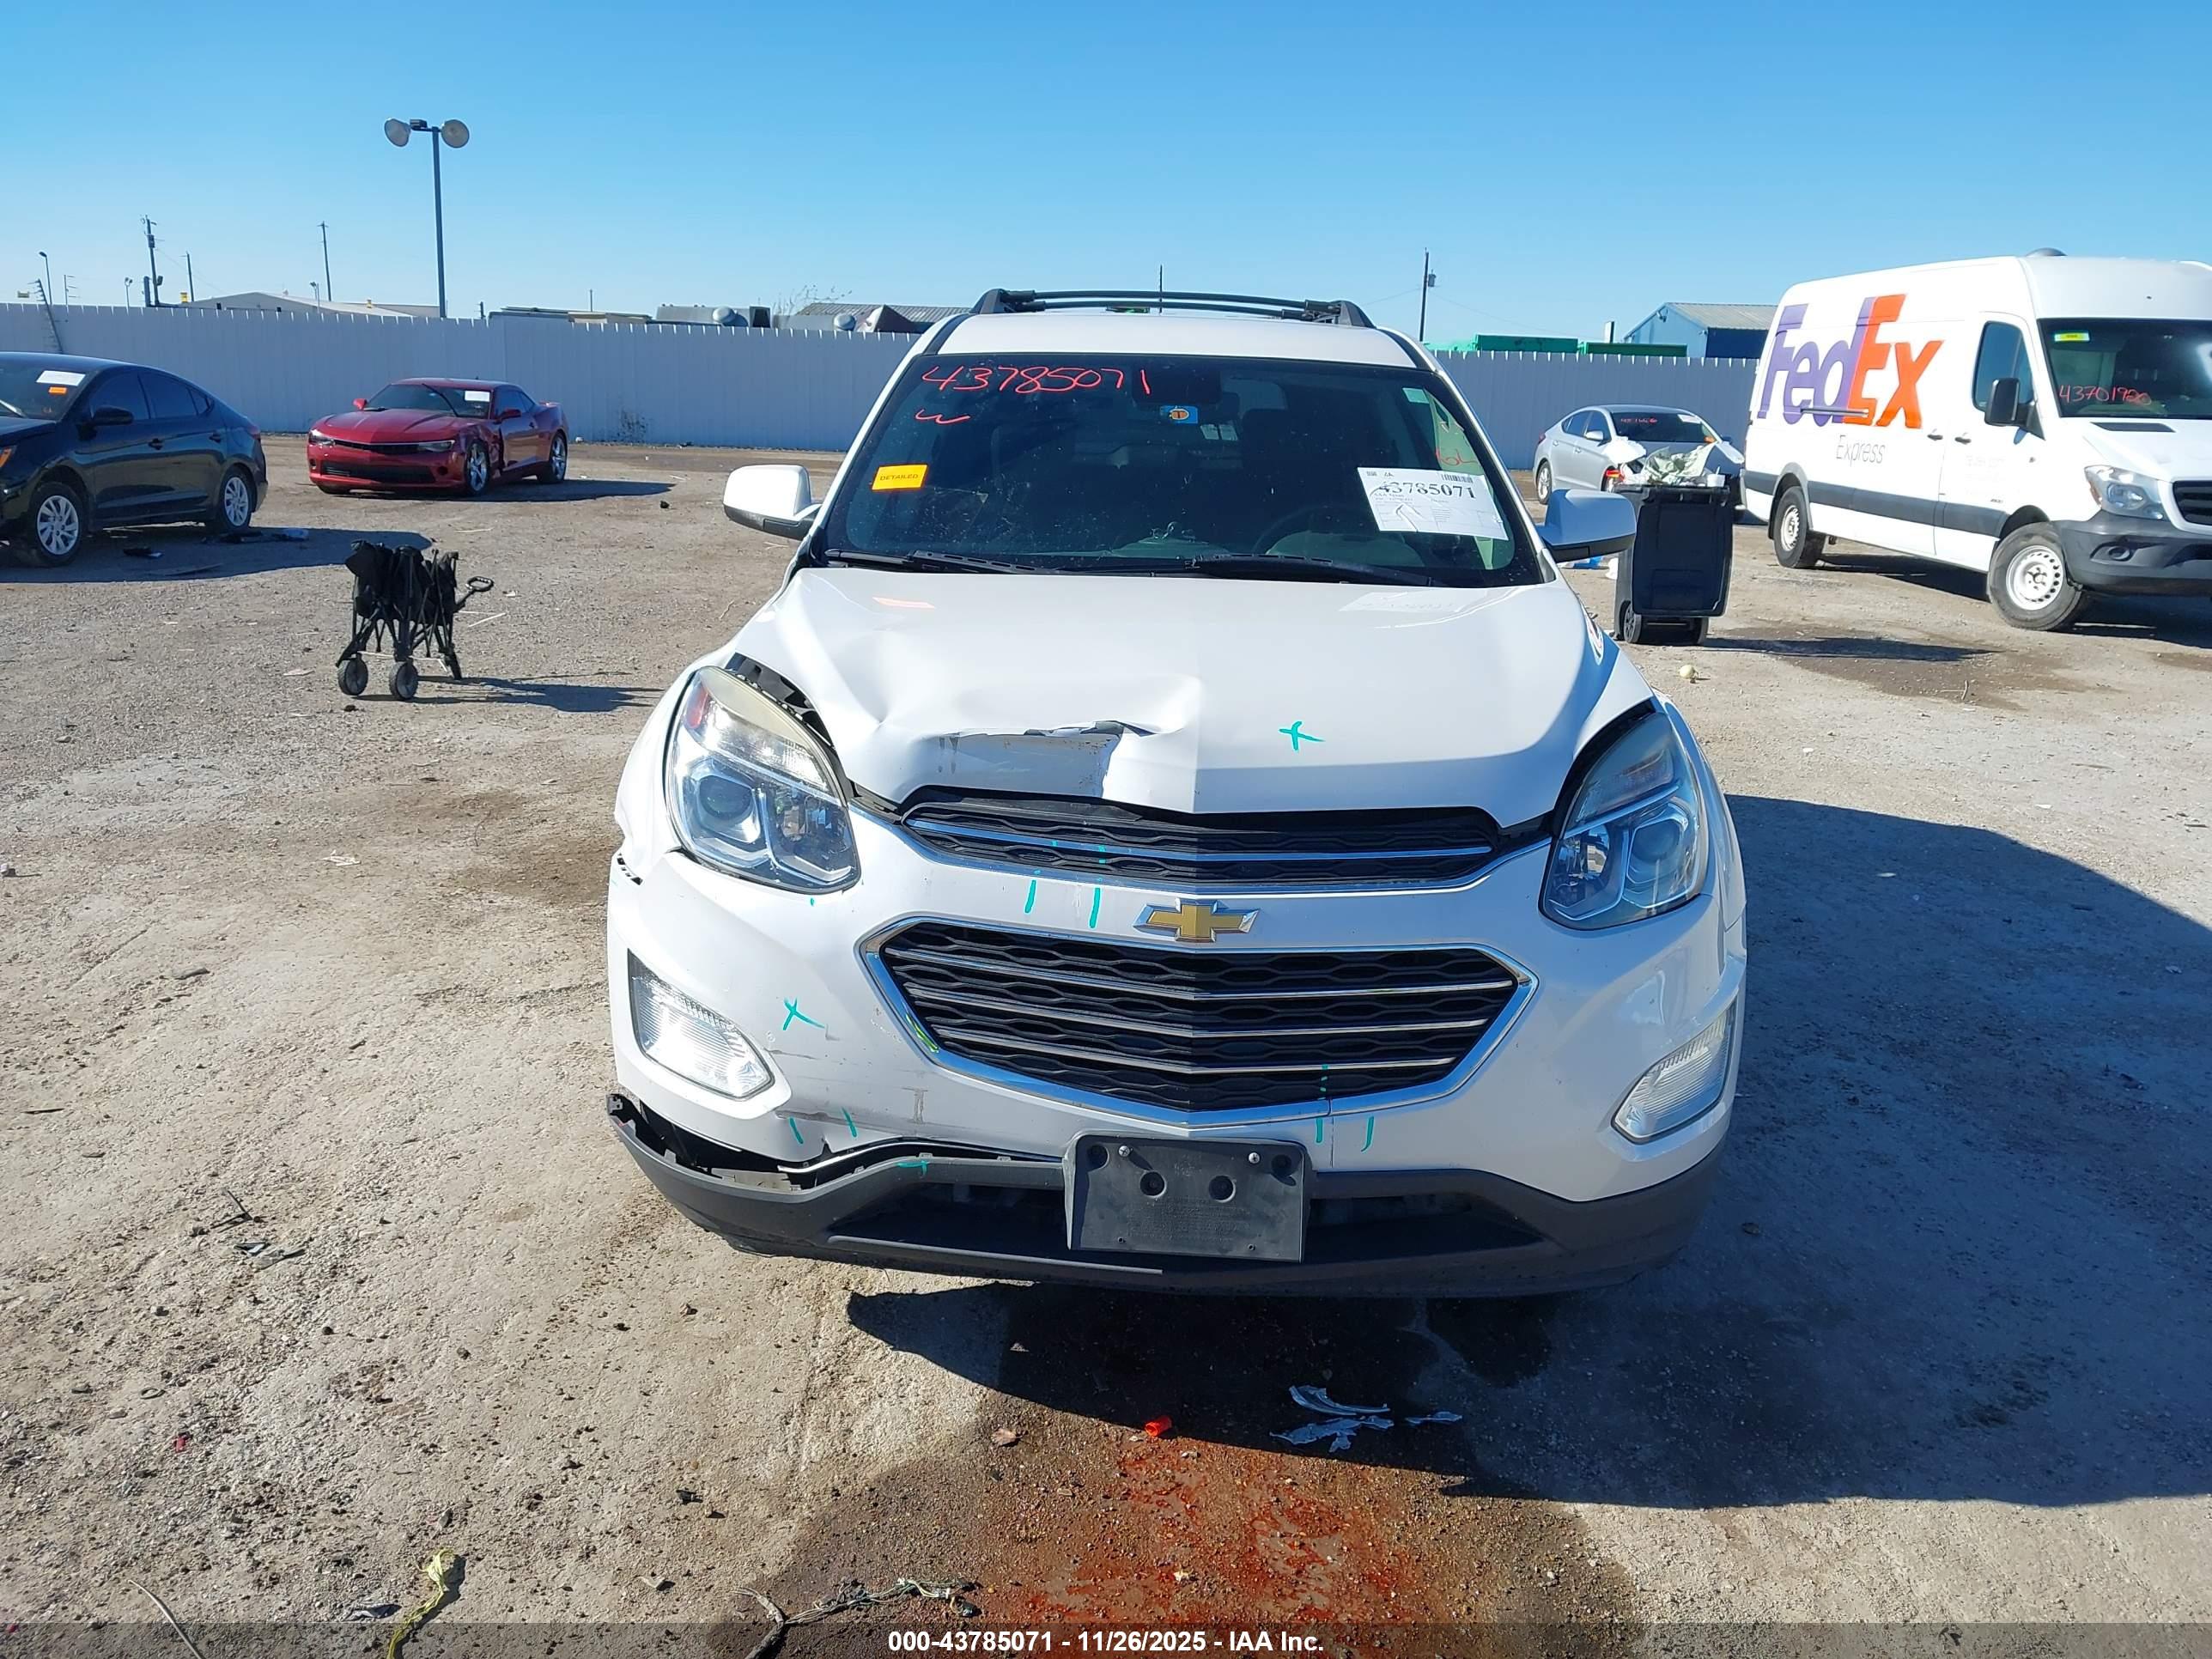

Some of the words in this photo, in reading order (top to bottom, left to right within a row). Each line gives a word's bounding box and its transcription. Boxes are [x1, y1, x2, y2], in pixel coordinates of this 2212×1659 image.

[1757, 294, 1946, 429] FedEx
[921, 365, 1152, 395] 43785071
[1836, 434, 1886, 466] Express
[1377, 481, 1476, 500] 43785071
